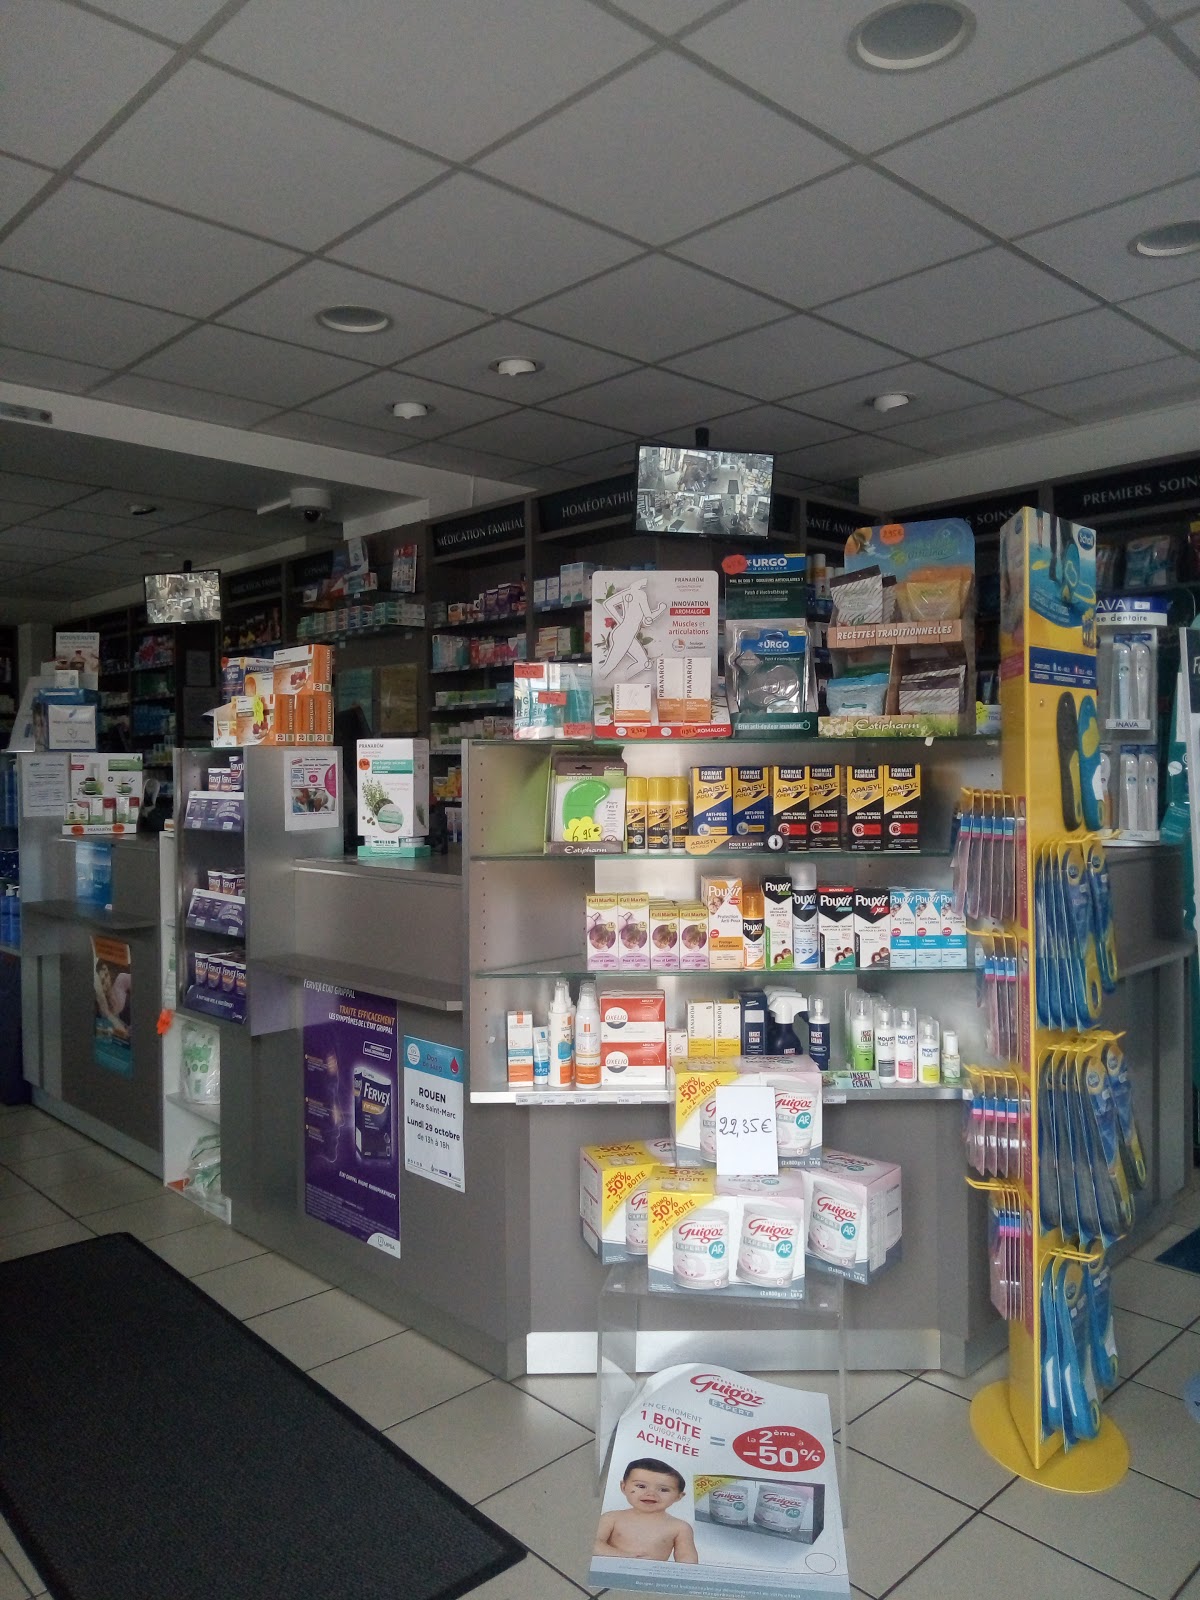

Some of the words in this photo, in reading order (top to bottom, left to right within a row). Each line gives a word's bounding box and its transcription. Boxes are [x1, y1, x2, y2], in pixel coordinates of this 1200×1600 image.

[1083, 484, 1152, 505] PREMIERS
[1159, 475, 1200, 493] SOIN
[752, 557, 788, 567] URGO
[1096, 599, 1126, 611] AVA
[672, 620, 698, 628] Muscles
[1110, 613, 1148, 623] dentaire
[837, 629, 876, 640] RECETTES
[877, 625, 953, 638] TRADITIONNELLES
[764, 640, 790, 649] URGO
[697, 783, 729, 795] APAISYL
[736, 783, 766, 794] APAISYL
[776, 784, 808, 794] APAISYL
[850, 783, 882, 794] APAISYL
[887, 783, 919, 793] APAISYL
[690, 839, 717, 847] APAISYL
[708, 885, 742, 897] Pouxit
[765, 882, 791, 893] Pouxit
[820, 894, 853, 908] Pouxit
[855, 894, 888, 908] Pouxit
[890, 894, 914, 904] Pouxit
[915, 894, 940, 904] Pouxit
[743, 923, 763, 933] Pouxit
[339, 1004, 357, 1017] TRAITE
[357, 1009, 396, 1026] EFFICACEMENT
[376, 1023, 393, 1035] GRIPPAL
[850, 1071, 871, 1080] INSECT
[678, 1076, 695, 1092] PROMO
[679, 1077, 706, 1104] -50%
[701, 1078, 721, 1096] BOITE
[363, 1082, 391, 1106] FERVEX
[418, 1087, 446, 1104] ROUEN
[410, 1098, 425, 1110] Place
[425, 1103, 456, 1120] Saint-Marc
[719, 1116, 773, 1138] 22,35€
[797, 1114, 811, 1125] AR
[406, 1116, 424, 1129] Lundi
[425, 1122, 433, 1132] 29
[434, 1125, 461, 1142] octobre
[417, 1132, 424, 1142] de
[425, 1134, 434, 1145] 13h
[605, 1171, 622, 1188] PROMO
[606, 1171, 632, 1200] -50%
[626, 1170, 646, 1189] BOITE
[650, 1196, 668, 1212] PROMO
[651, 1196, 679, 1223] -50%
[674, 1199, 695, 1217] BOITE
[817, 1196, 858, 1222] Guigoz
[678, 1221, 724, 1244] Guigoz
[748, 1218, 794, 1242] Guigoz
[842, 1225, 856, 1237] AR
[710, 1243, 724, 1254] AR
[777, 1243, 792, 1254] AR
[690, 1373, 765, 1408] Guigoz
[655, 1403, 667, 1412] CE
[667, 1406, 703, 1423] MOMENT
[711, 1399, 752, 1417] EXPERT
[640, 1410, 647, 1421] 1
[653, 1412, 702, 1440] BOÎTE
[648, 1423, 675, 1439] GUIGOZ
[636, 1429, 700, 1457] ACHETÉE
[758, 1429, 796, 1444] 2ème
[712, 1490, 744, 1502] Guigoz
[763, 1493, 802, 1508] Guigoz
